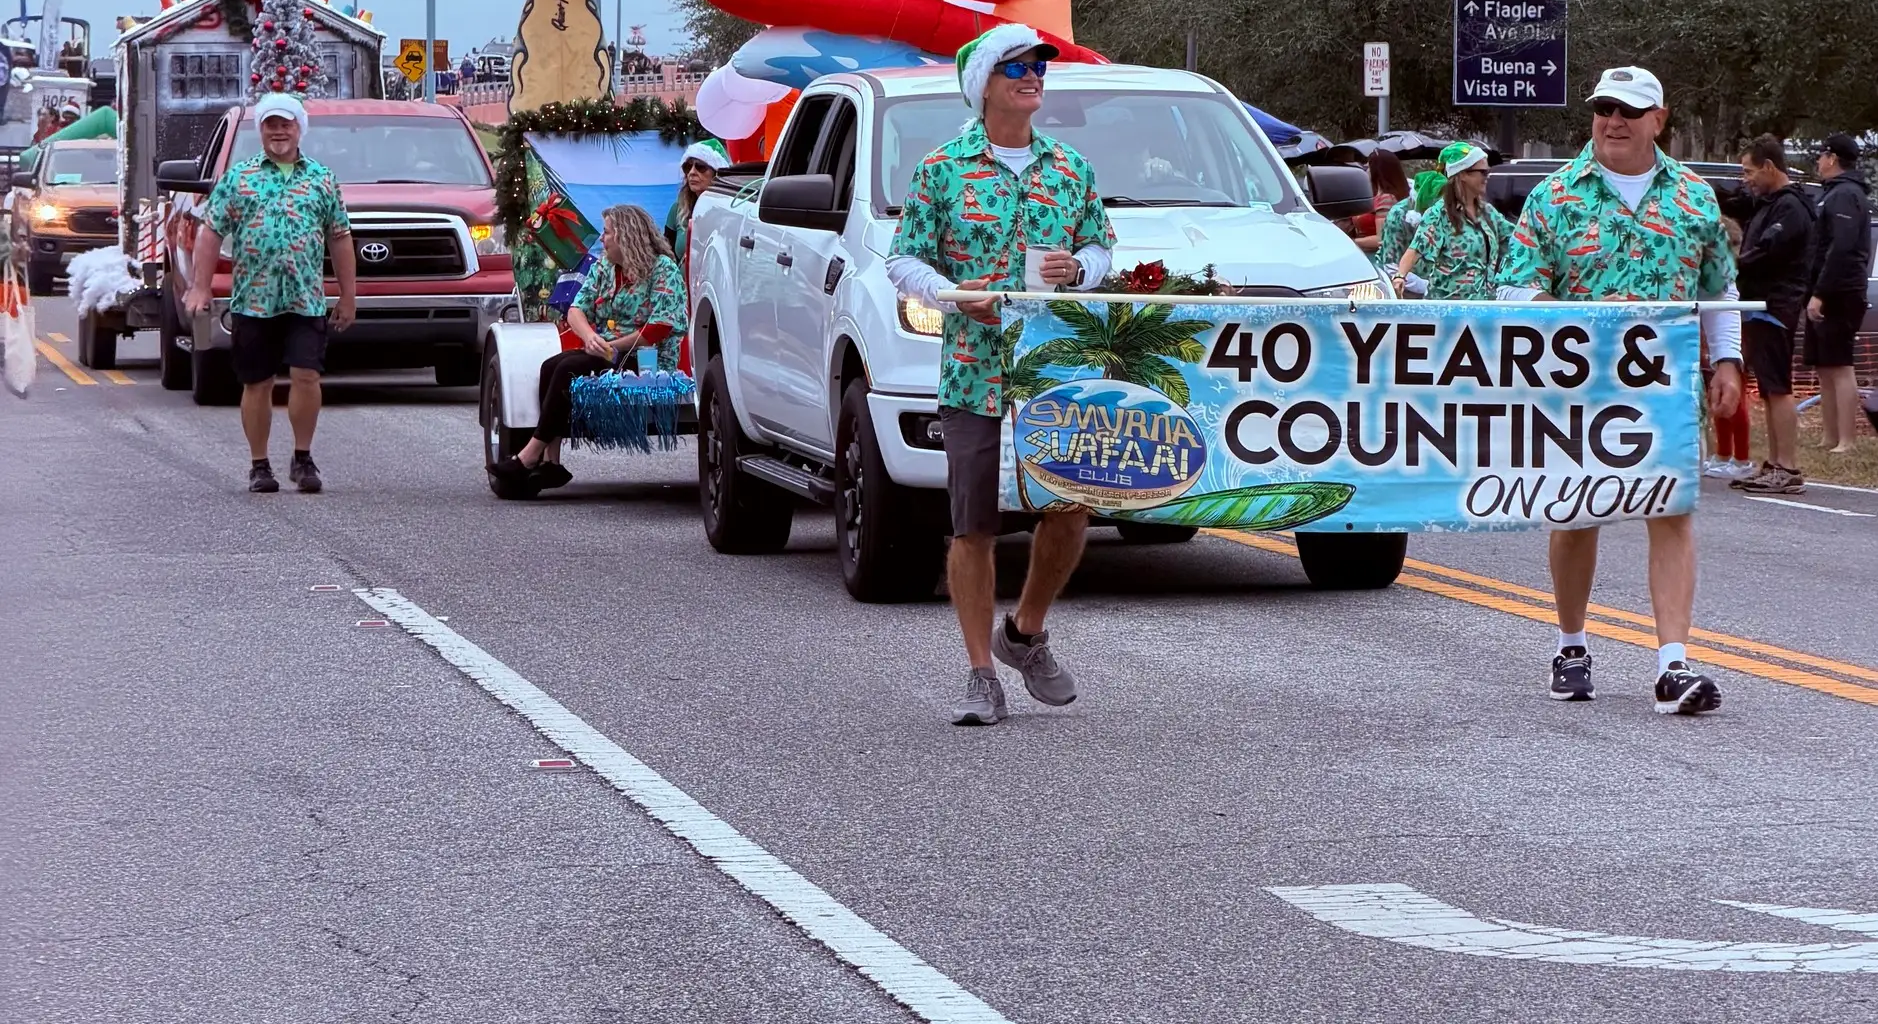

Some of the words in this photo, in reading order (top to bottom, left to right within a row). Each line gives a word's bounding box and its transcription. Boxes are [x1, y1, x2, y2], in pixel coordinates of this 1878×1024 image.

[1484, 0, 1545, 22] Flagler
[1484, 23, 1518, 40] Ave
[1523, 23, 1556, 41] Di
[1371, 46, 1382, 57] NO
[1481, 57, 1536, 75] Buena
[1463, 79, 1508, 97] Vista
[1513, 80, 1537, 98] Pk
[1207, 322, 1312, 383] 40
[1340, 322, 1590, 388] YEARS
[1617, 324, 1671, 388] &
[1224, 399, 1653, 469] COUNTING
[1024, 428, 1190, 481] SURFARI
[1078, 468, 1132, 487] CLUB
[1466, 474, 1547, 519] ON
[1544, 474, 1678, 524] YOU!
